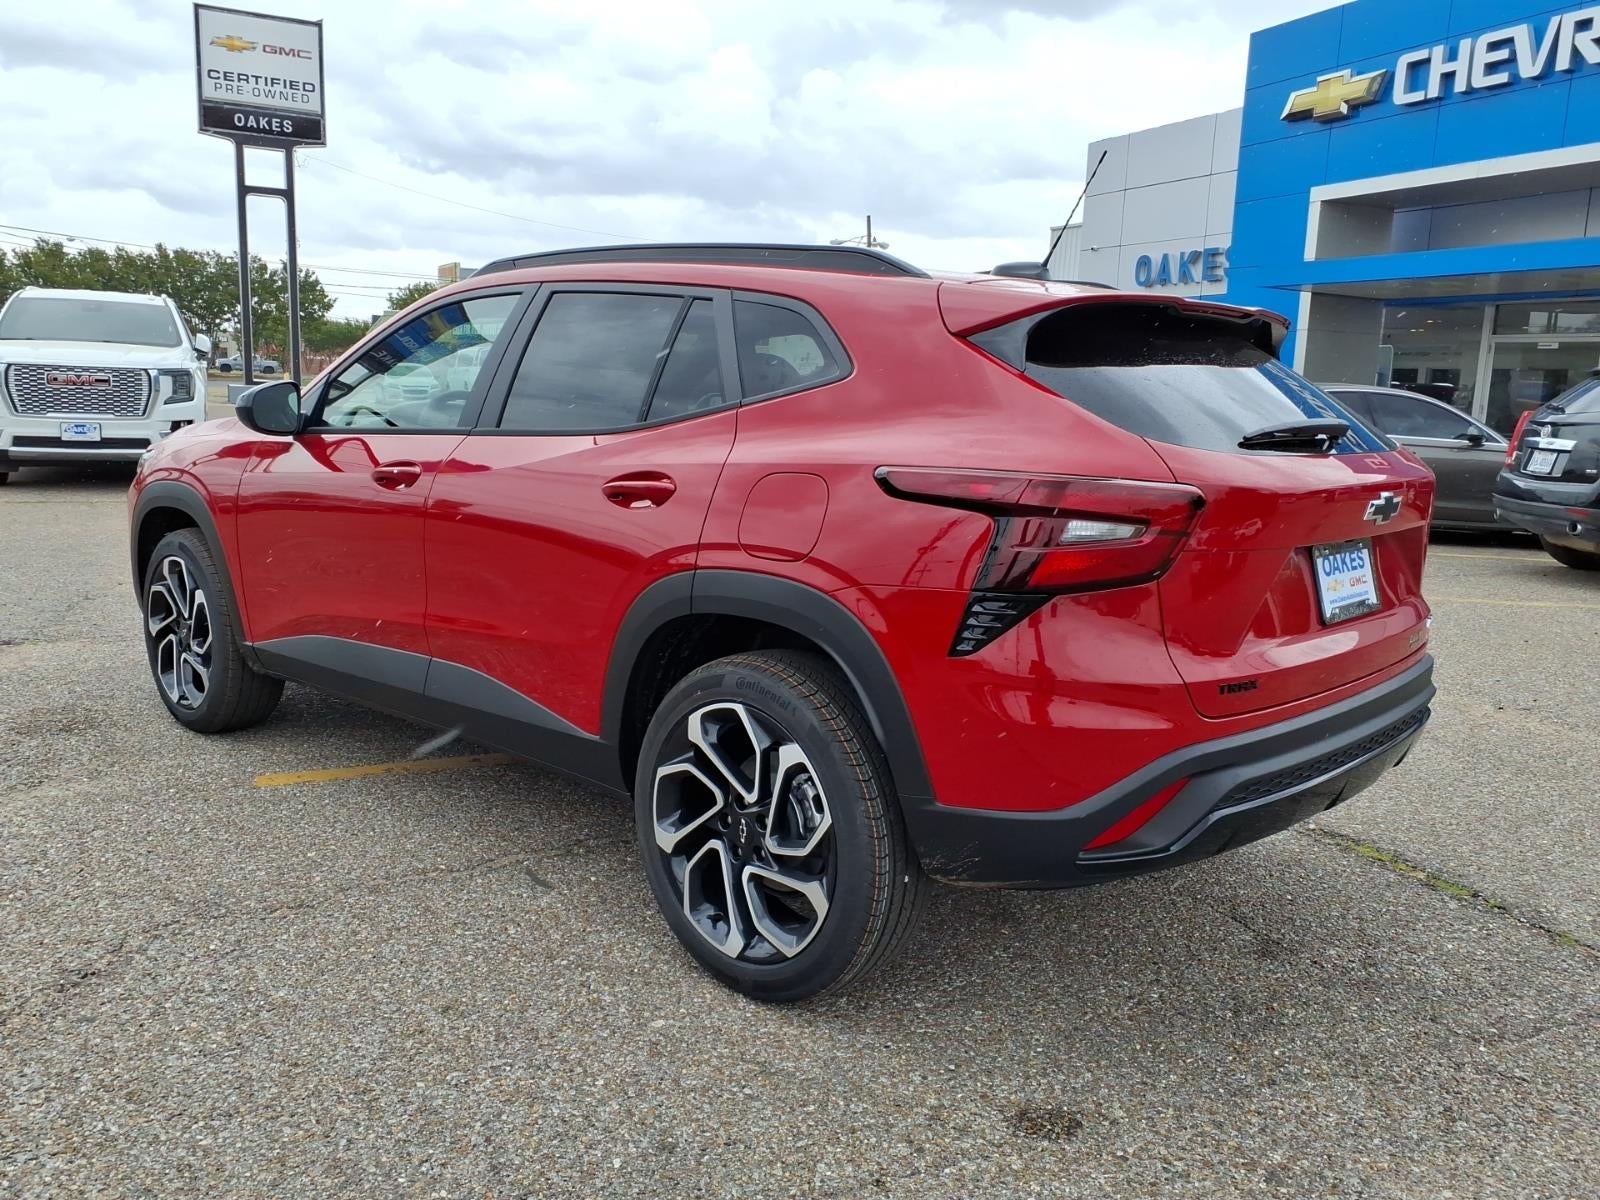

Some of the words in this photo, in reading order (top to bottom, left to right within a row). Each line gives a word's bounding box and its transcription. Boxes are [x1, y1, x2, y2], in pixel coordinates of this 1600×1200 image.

[262, 44, 312, 60] GMC
[207, 69, 316, 93] CERTIFIED
[214, 82, 310, 104] PRE-OWNED
[234, 113, 293, 133] OAKES
[47, 374, 110, 387] GMC
[1322, 550, 1365, 577] OAKES
[1349, 575, 1368, 587] GMC
